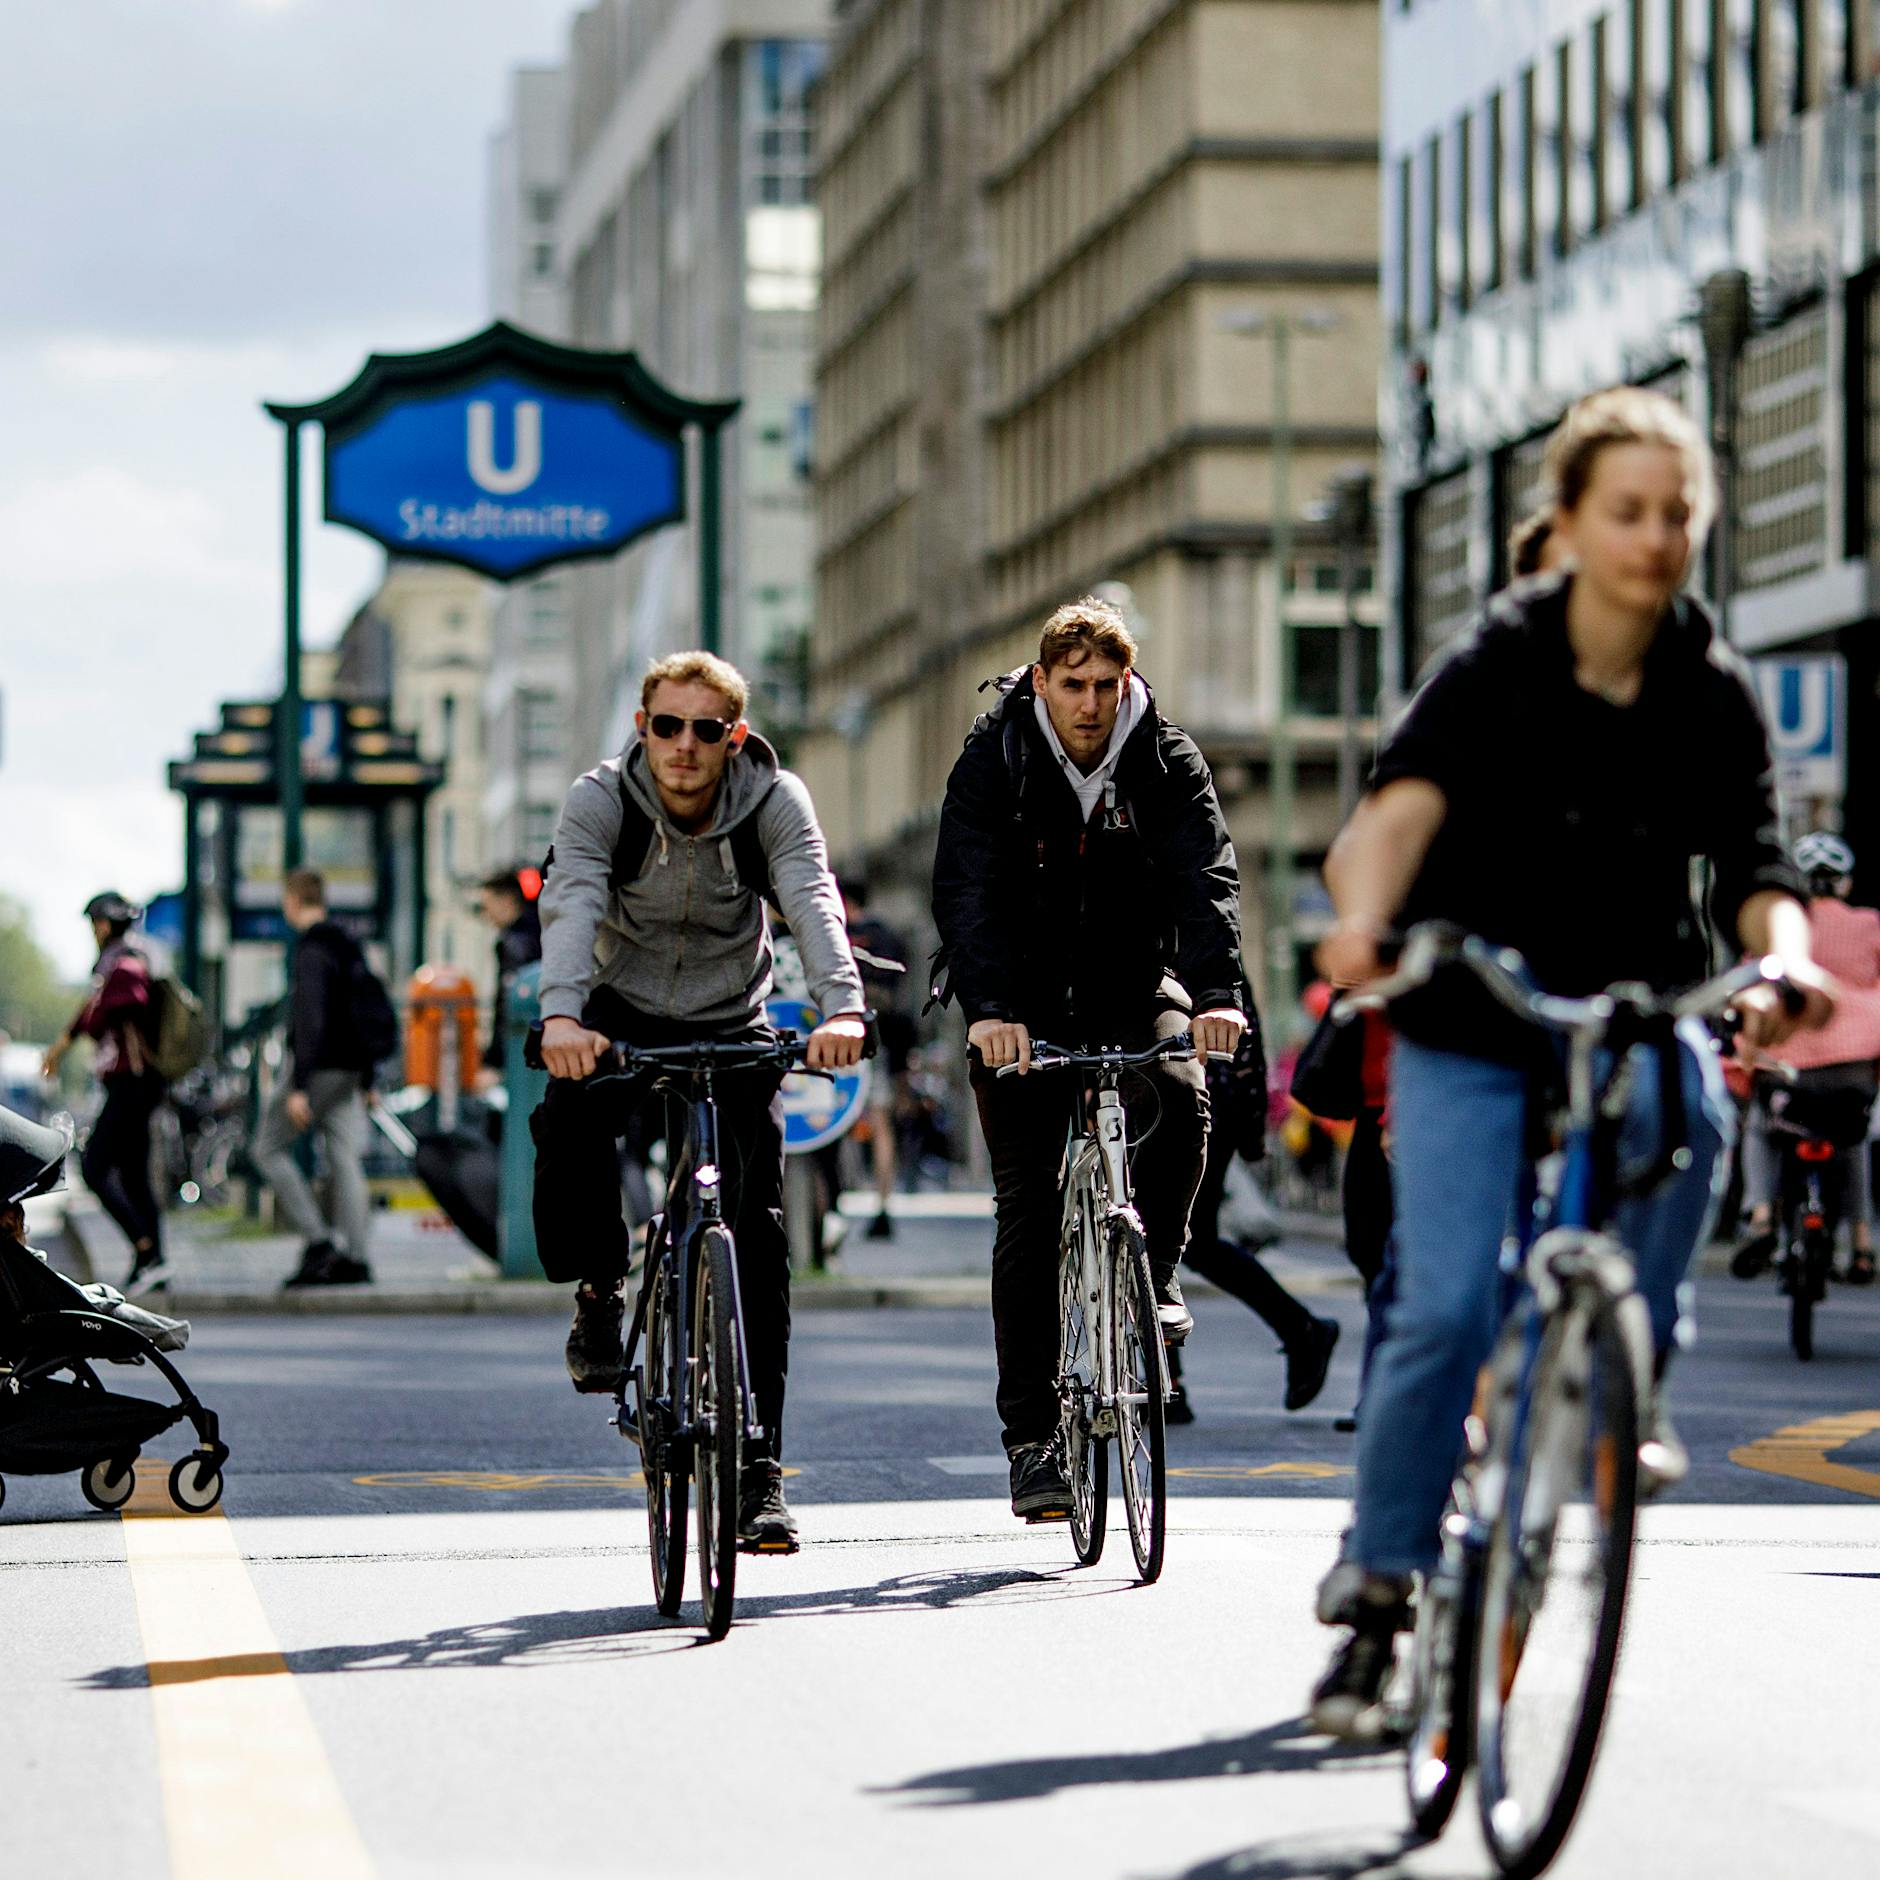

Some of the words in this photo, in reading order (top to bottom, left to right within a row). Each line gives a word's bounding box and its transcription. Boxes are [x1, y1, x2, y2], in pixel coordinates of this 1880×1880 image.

[467, 399, 541, 494] U
[400, 499, 609, 540] Stadtmitte
[1759, 661, 1826, 749] U
